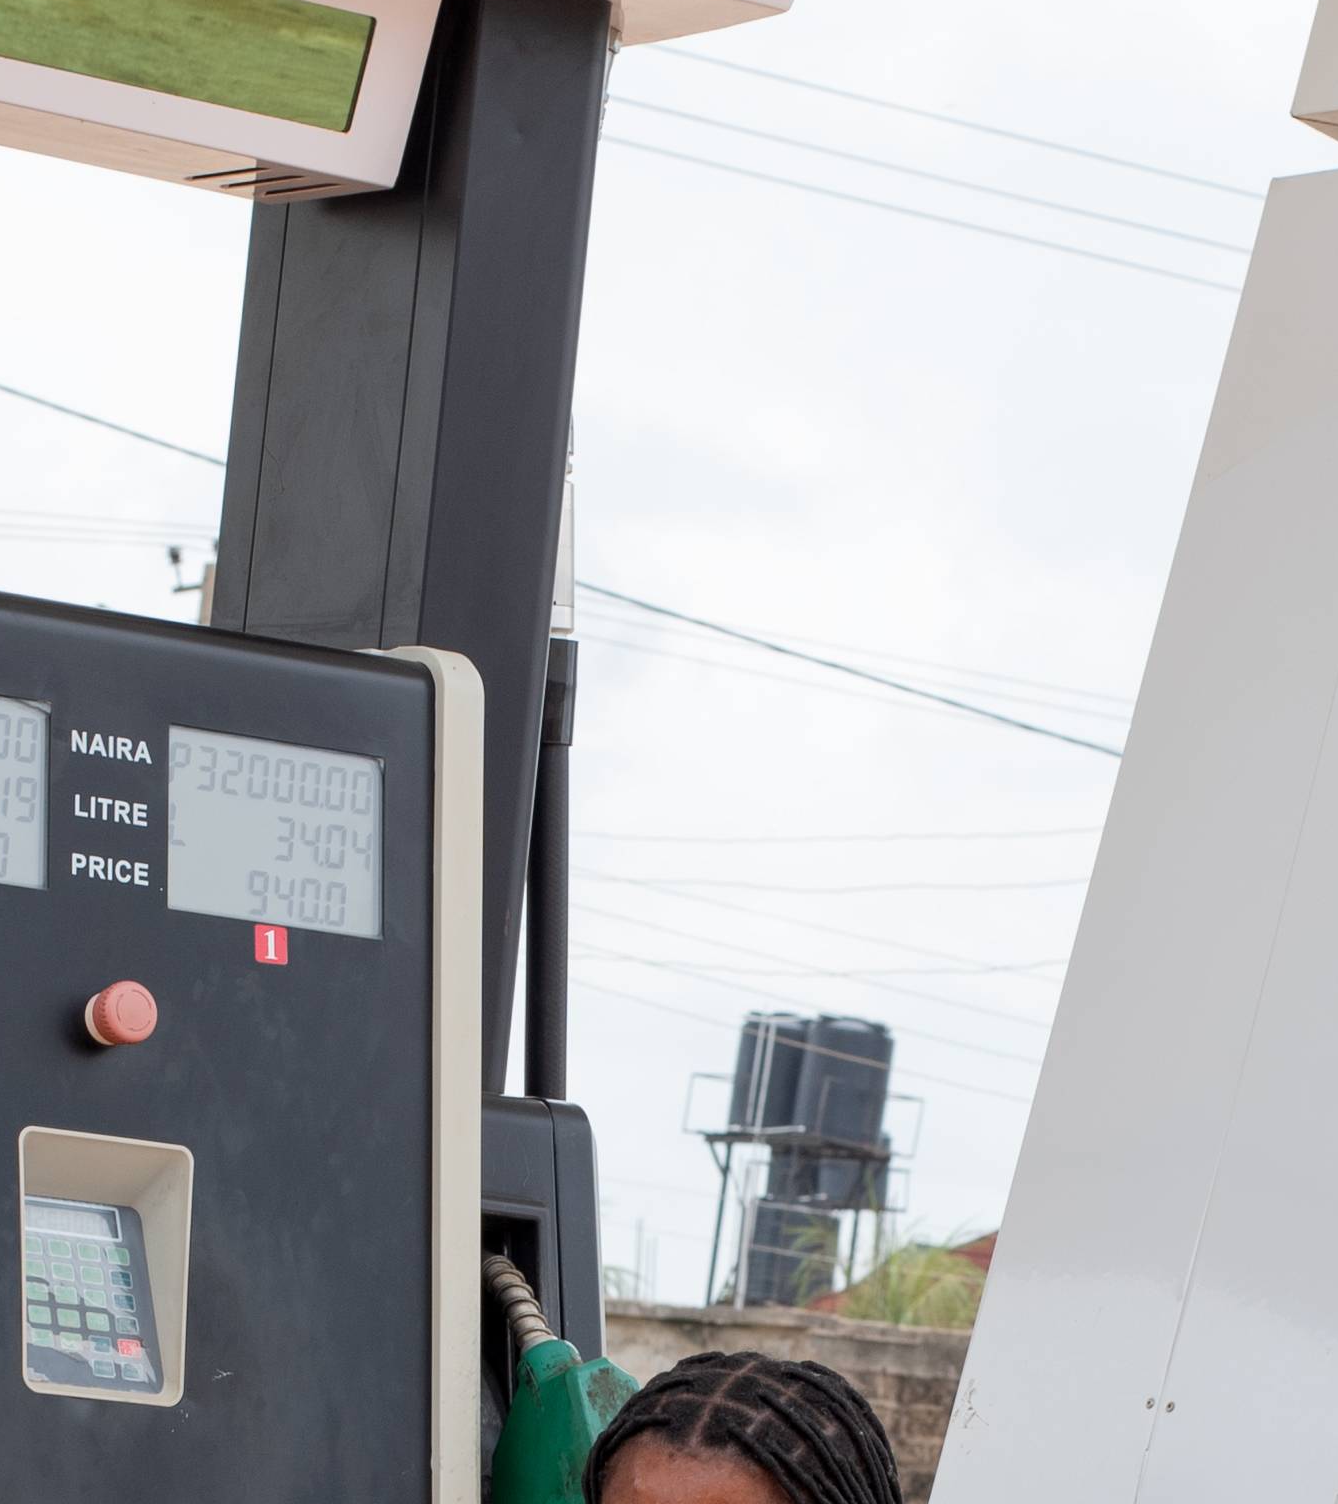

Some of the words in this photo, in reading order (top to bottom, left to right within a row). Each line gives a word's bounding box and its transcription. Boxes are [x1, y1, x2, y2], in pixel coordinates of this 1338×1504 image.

[71, 729, 151, 763] NAIRA
[74, 794, 147, 826] LITRE
[71, 853, 148, 885] PRICE
[264, 929, 279, 960] 1
